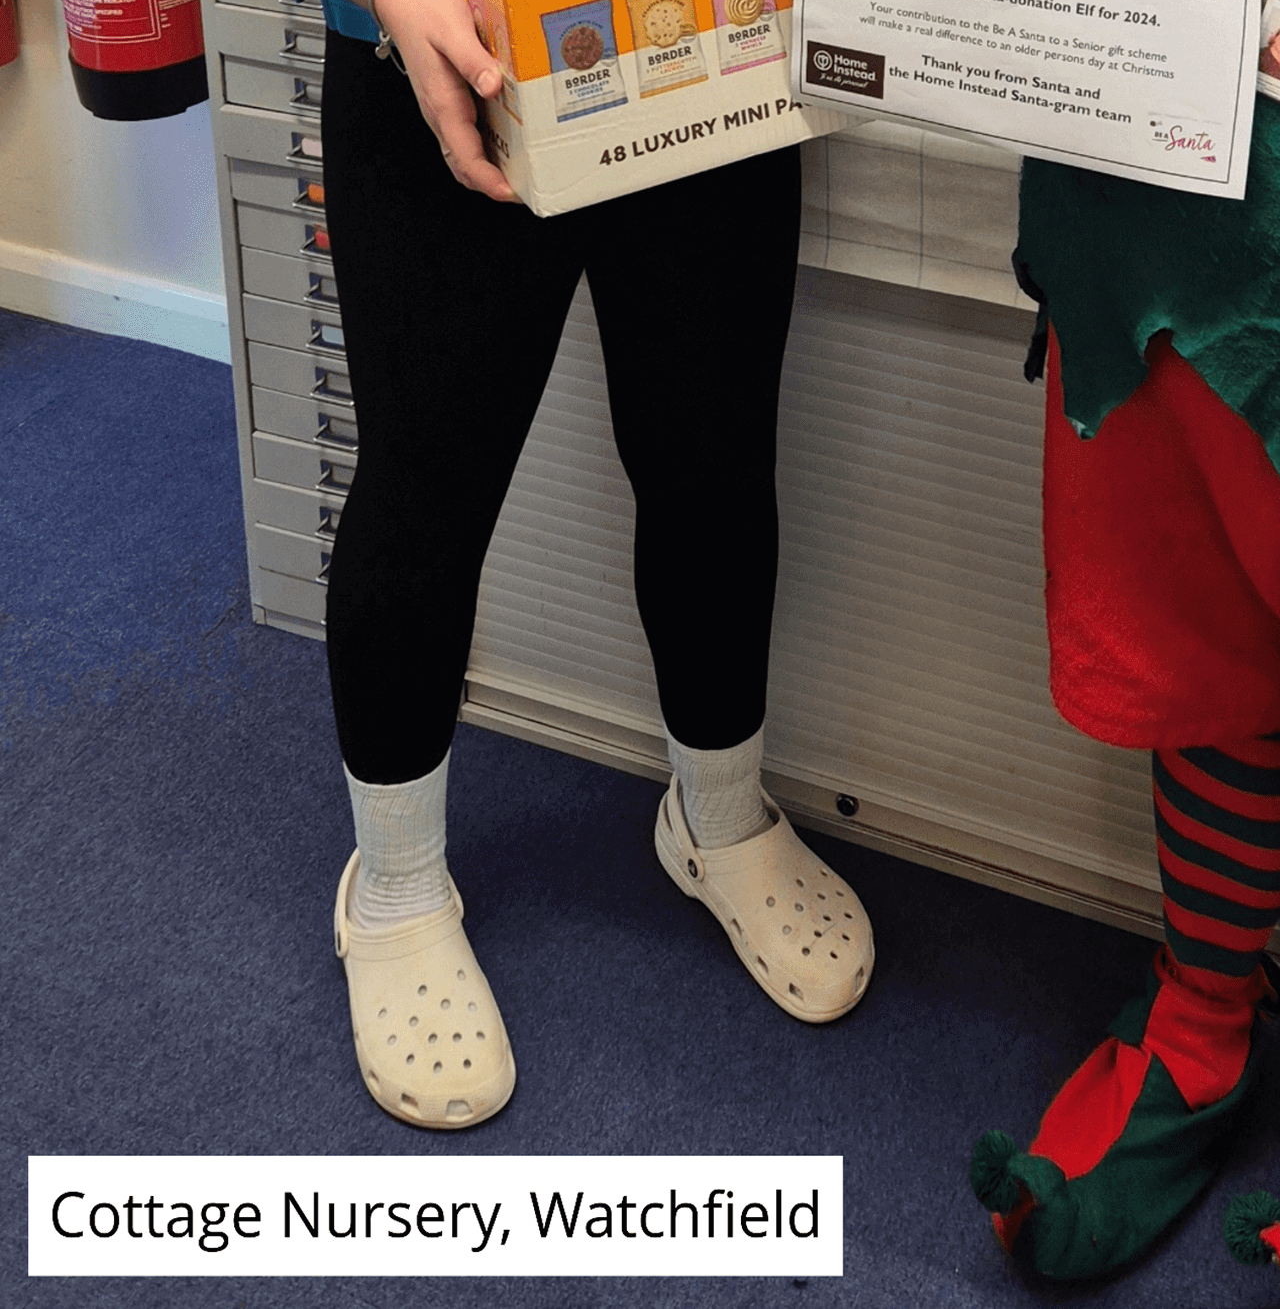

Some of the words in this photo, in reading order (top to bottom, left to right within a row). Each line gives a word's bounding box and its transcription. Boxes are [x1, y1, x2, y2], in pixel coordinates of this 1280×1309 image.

[870, 1, 894, 14] Your
[897, 8, 956, 26] contribution
[959, 20, 970, 29] to
[973, 22, 989, 32] the
[993, 24, 1005, 35] Be
[1008, 28, 1016, 37] A
[1019, 29, 1046, 43] Santa
[1049, 36, 1060, 45] to
[1072, 38, 1106, 52] Senior
[1108, 45, 1124, 57] gift
[1128, 49, 1168, 62] scheme
[1076, 2, 1096, 17] Elf
[1098, 6, 1120, 20] for
[1124, 10, 1160, 27] 2024.
[833, 54, 868, 70] Home
[859, 16, 875, 25] will
[878, 19, 903, 31] make
[906, 24, 912, 32] a
[915, 26, 933, 36] real
[935, 29, 983, 46] difference
[986, 39, 997, 49] to
[1000, 42, 1011, 51] an
[1015, 44, 1041, 56] older
[1044, 50, 1084, 65] persons
[1088, 57, 1105, 70] day
[1108, 62, 1118, 70] at
[1122, 62, 1175, 79] Christmas
[833, 64, 876, 81] Instead
[921, 54, 963, 73] Thank
[966, 65, 990, 79] you
[995, 69, 1027, 86] from
[1032, 76, 1070, 94] Santa
[1075, 88, 1101, 100] and
[889, 66, 909, 79] the
[913, 70, 954, 88] Home
[959, 79, 1007, 99] Instead
[1011, 90, 1090, 115] Santa-gram
[1095, 107, 1132, 124] team
[599, 145, 626, 166] 48
[632, 118, 718, 157] LUXURY
[723, 102, 770, 131] MINI
[1154, 131, 1163, 139] BE
[1165, 125, 1216, 151] Santa
